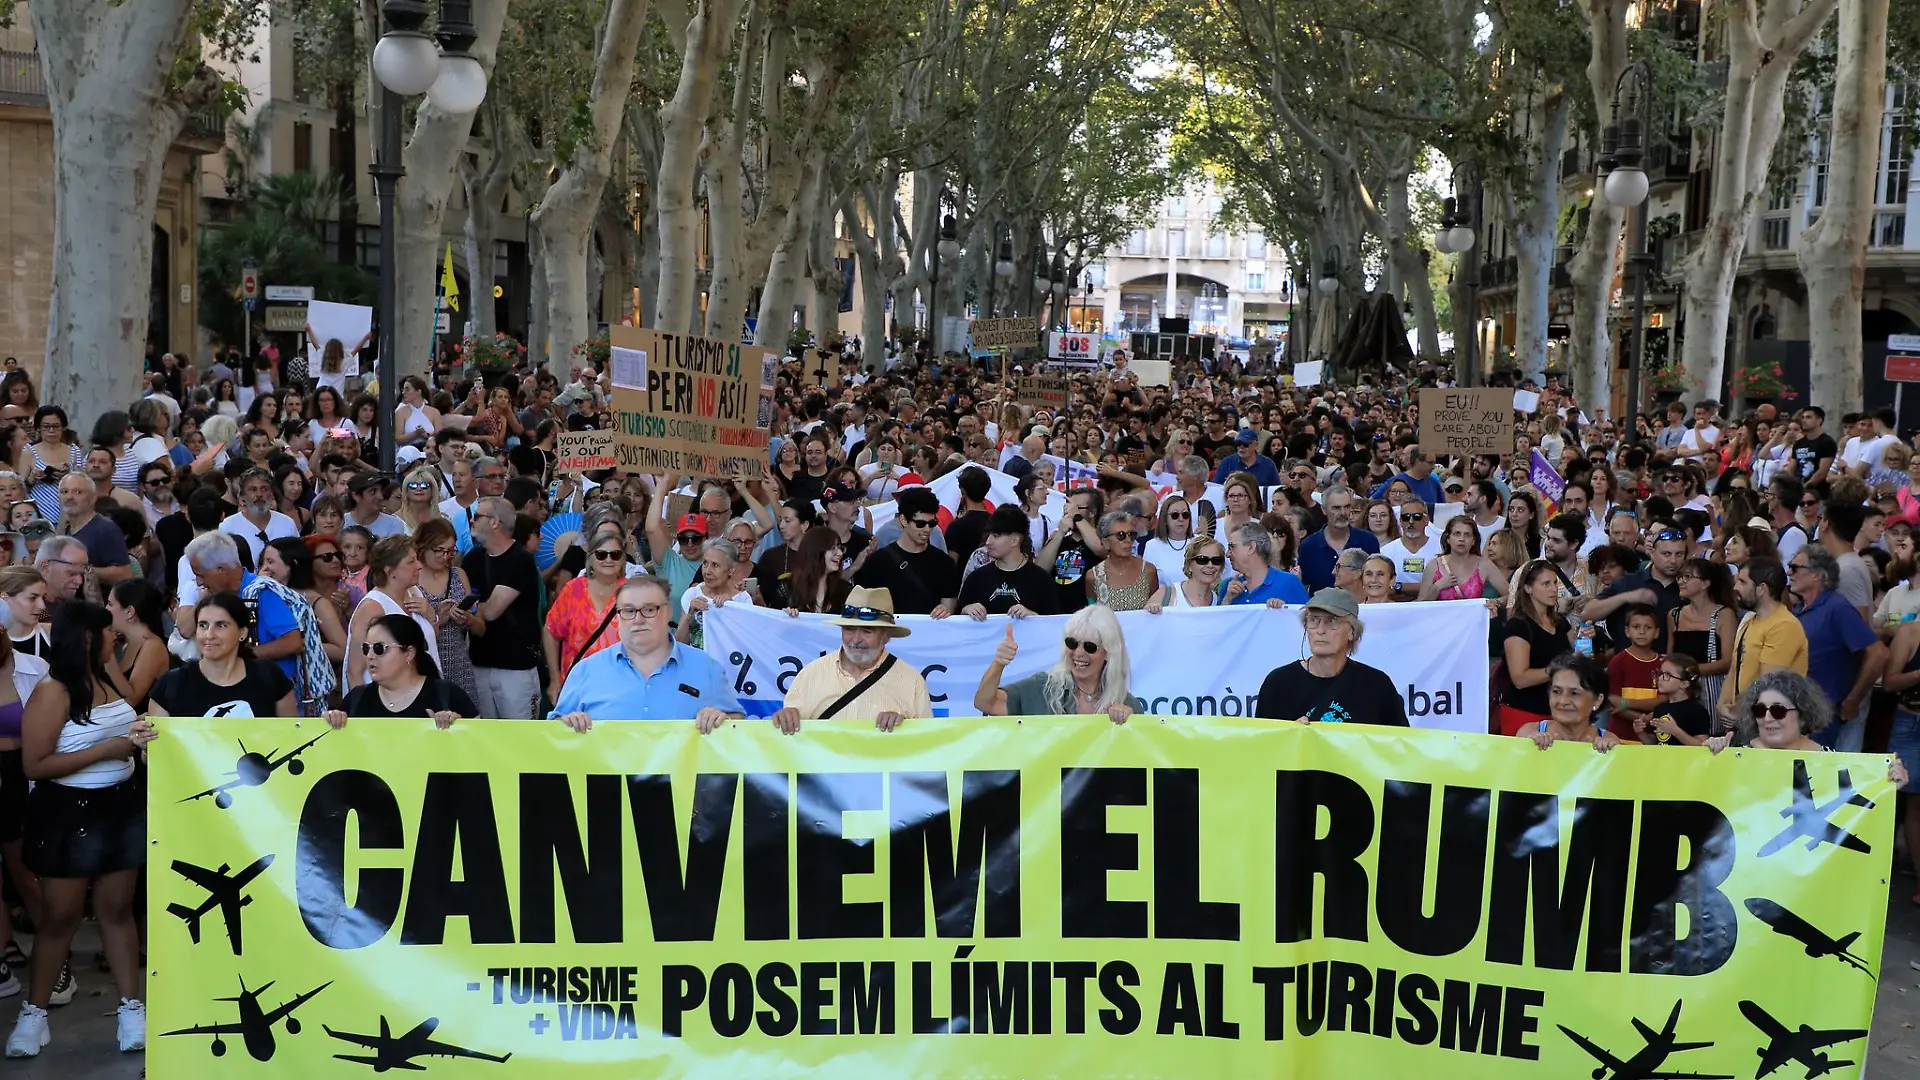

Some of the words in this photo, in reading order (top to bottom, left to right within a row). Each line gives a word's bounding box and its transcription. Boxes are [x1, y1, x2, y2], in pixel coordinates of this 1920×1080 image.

[1059, 336, 1090, 352] SOS
[1022, 379, 1034, 388] EL
[648, 370, 693, 414] PERO
[697, 375, 716, 417] NO
[1018, 391, 1036, 399] MATA
[1446, 394, 1480, 410] EU!!
[1435, 410, 1471, 421] PROVE
[1481, 411, 1504, 423] YOU
[1433, 424, 1465, 433] CARE
[1469, 424, 1511, 435] ABOUT
[1447, 436, 1497, 448] PEOPLE
[295, 768, 1022, 949] CANVIEM
[1061, 767, 1240, 941] EL
[1275, 769, 1739, 977] RUMB
[487, 966, 638, 1004] TURISME
[662, 962, 895, 1038] POSEM
[912, 945, 1141, 1035] LÍMITS
[1156, 962, 1240, 1040] AL
[1252, 959, 1546, 1061] TURISME
[557, 1003, 638, 1041] VIDA
